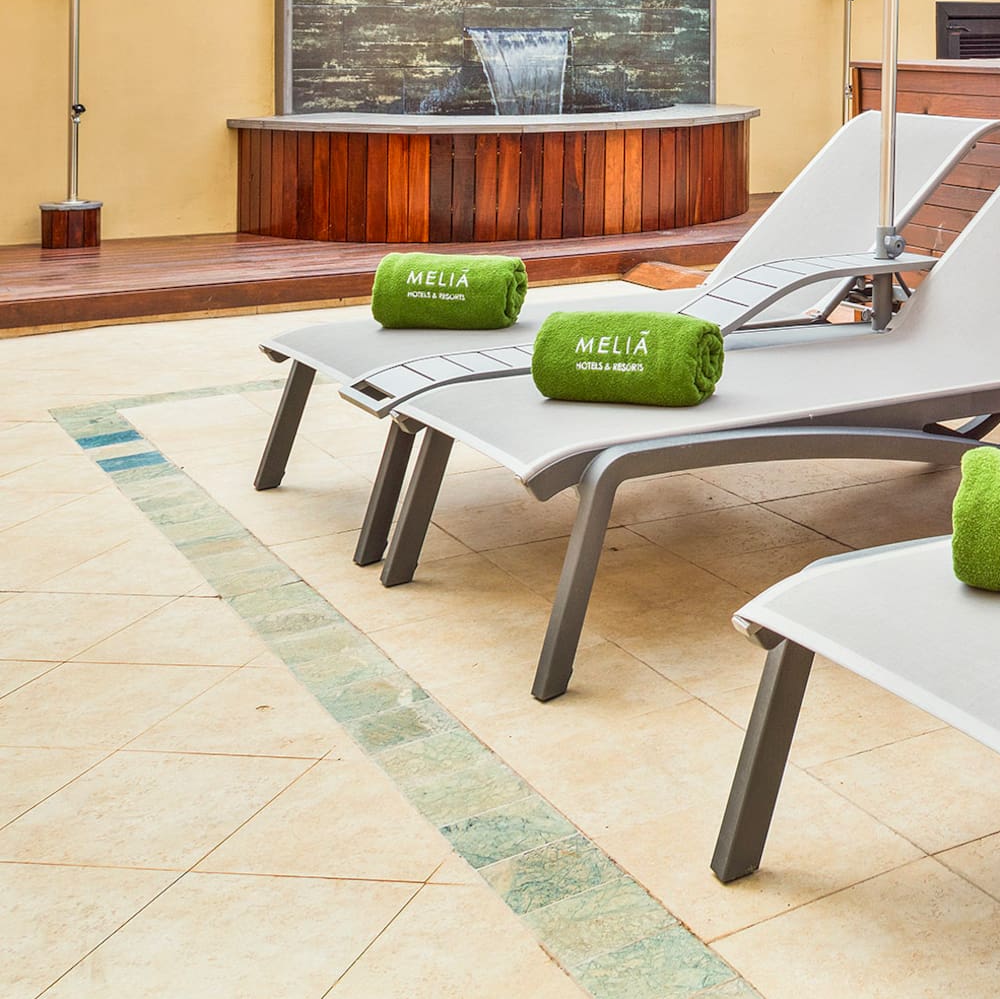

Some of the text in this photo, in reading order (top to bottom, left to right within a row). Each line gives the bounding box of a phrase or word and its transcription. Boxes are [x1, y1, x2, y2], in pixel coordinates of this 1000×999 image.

[407, 291, 431, 299] HOTELS
[439, 292, 466, 301] RESORTS
[576, 361, 644, 372] HOTELS & RESORTS
